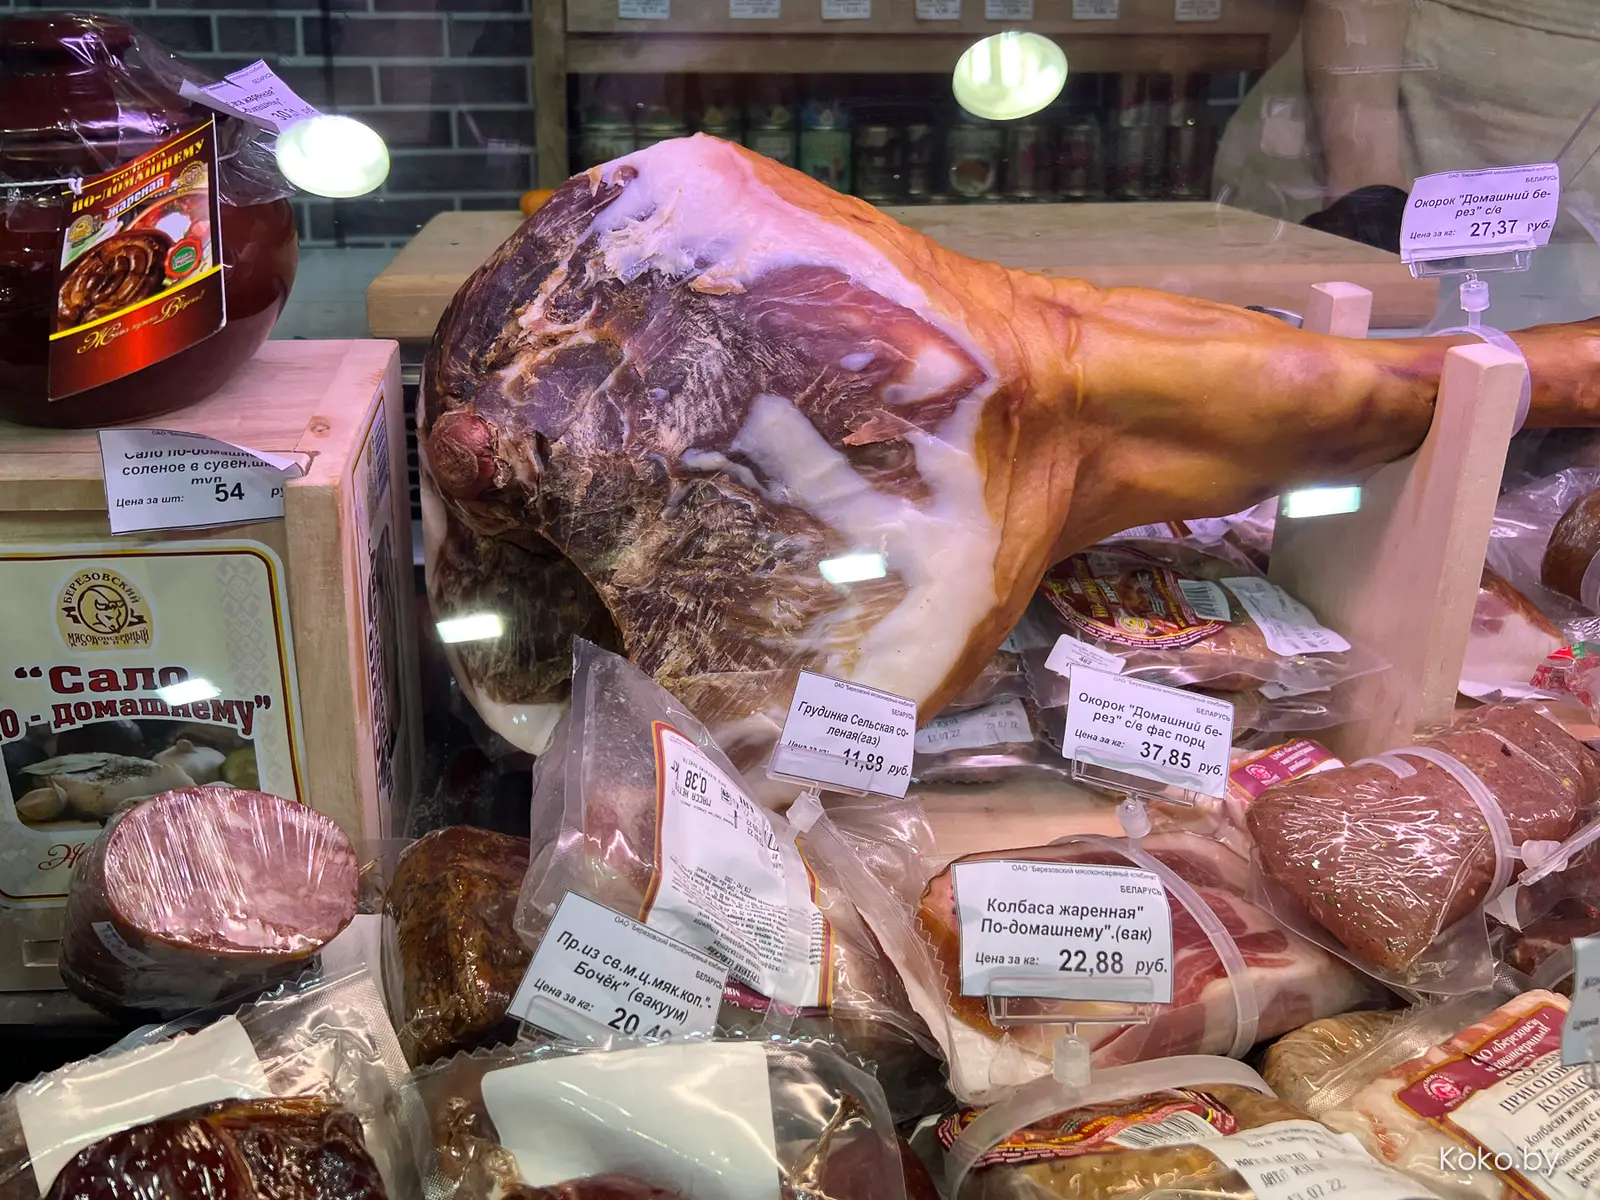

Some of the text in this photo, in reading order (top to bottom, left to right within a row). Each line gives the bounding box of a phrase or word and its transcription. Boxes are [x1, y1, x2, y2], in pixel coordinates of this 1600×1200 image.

[1414, 189, 1551, 208] Окорок "Домашний бе-
[1455, 206, 1502, 219] рез" с/в
[1410, 219, 1551, 240] Цена за кг: 27,37 руб.
[122, 462, 186, 476] соленое
[190, 462, 199, 471] в
[116, 497, 144, 508] Цена
[146, 496, 159, 504] за
[161, 495, 184, 504] шт:
[215, 482, 245, 502] 54
[63, 572, 141, 604] БЕРЕЗОВСКИЙ
[0, 708, 21, 739] о
[797, 701, 909, 738] Грудинка Сельская со-
[891, 708, 915, 720] БЕЛАРУСЬ
[1078, 692, 1223, 737] Окорок "Домашний бе-
[1196, 707, 1231, 722] БЕЛАРУСЬ
[826, 726, 881, 748] леная(газ)
[1092, 711, 1206, 751] рез" с/в фас порц
[843, 748, 884, 772] 11,88
[887, 764, 909, 777] руб.
[1074, 728, 1224, 777] Цена за кг: 37,85 руб.
[684, 769, 707, 794] 0,38
[1120, 885, 1162, 896] БЕЛАРУСЬ
[986, 898, 1144, 920] Колбаса жаренная"
[981, 918, 1152, 944] По-домашнему".(вак)
[556, 930, 601, 960] Пр.из
[975, 949, 1168, 976] Цена за кг: 22,88 руб.
[573, 960, 690, 1026] Бочёк" (вакуум)
[695, 970, 723, 990] БЕЛАРУСЬ
[533, 977, 561, 998] Цена
[563, 992, 577, 1004] за
[577, 998, 594, 1012] кг:
[1499, 1063, 1579, 1112] ПРИГОТОВ
[1525, 1115, 1568, 1147] Колбаски
[1564, 1118, 1592, 1141] минут
